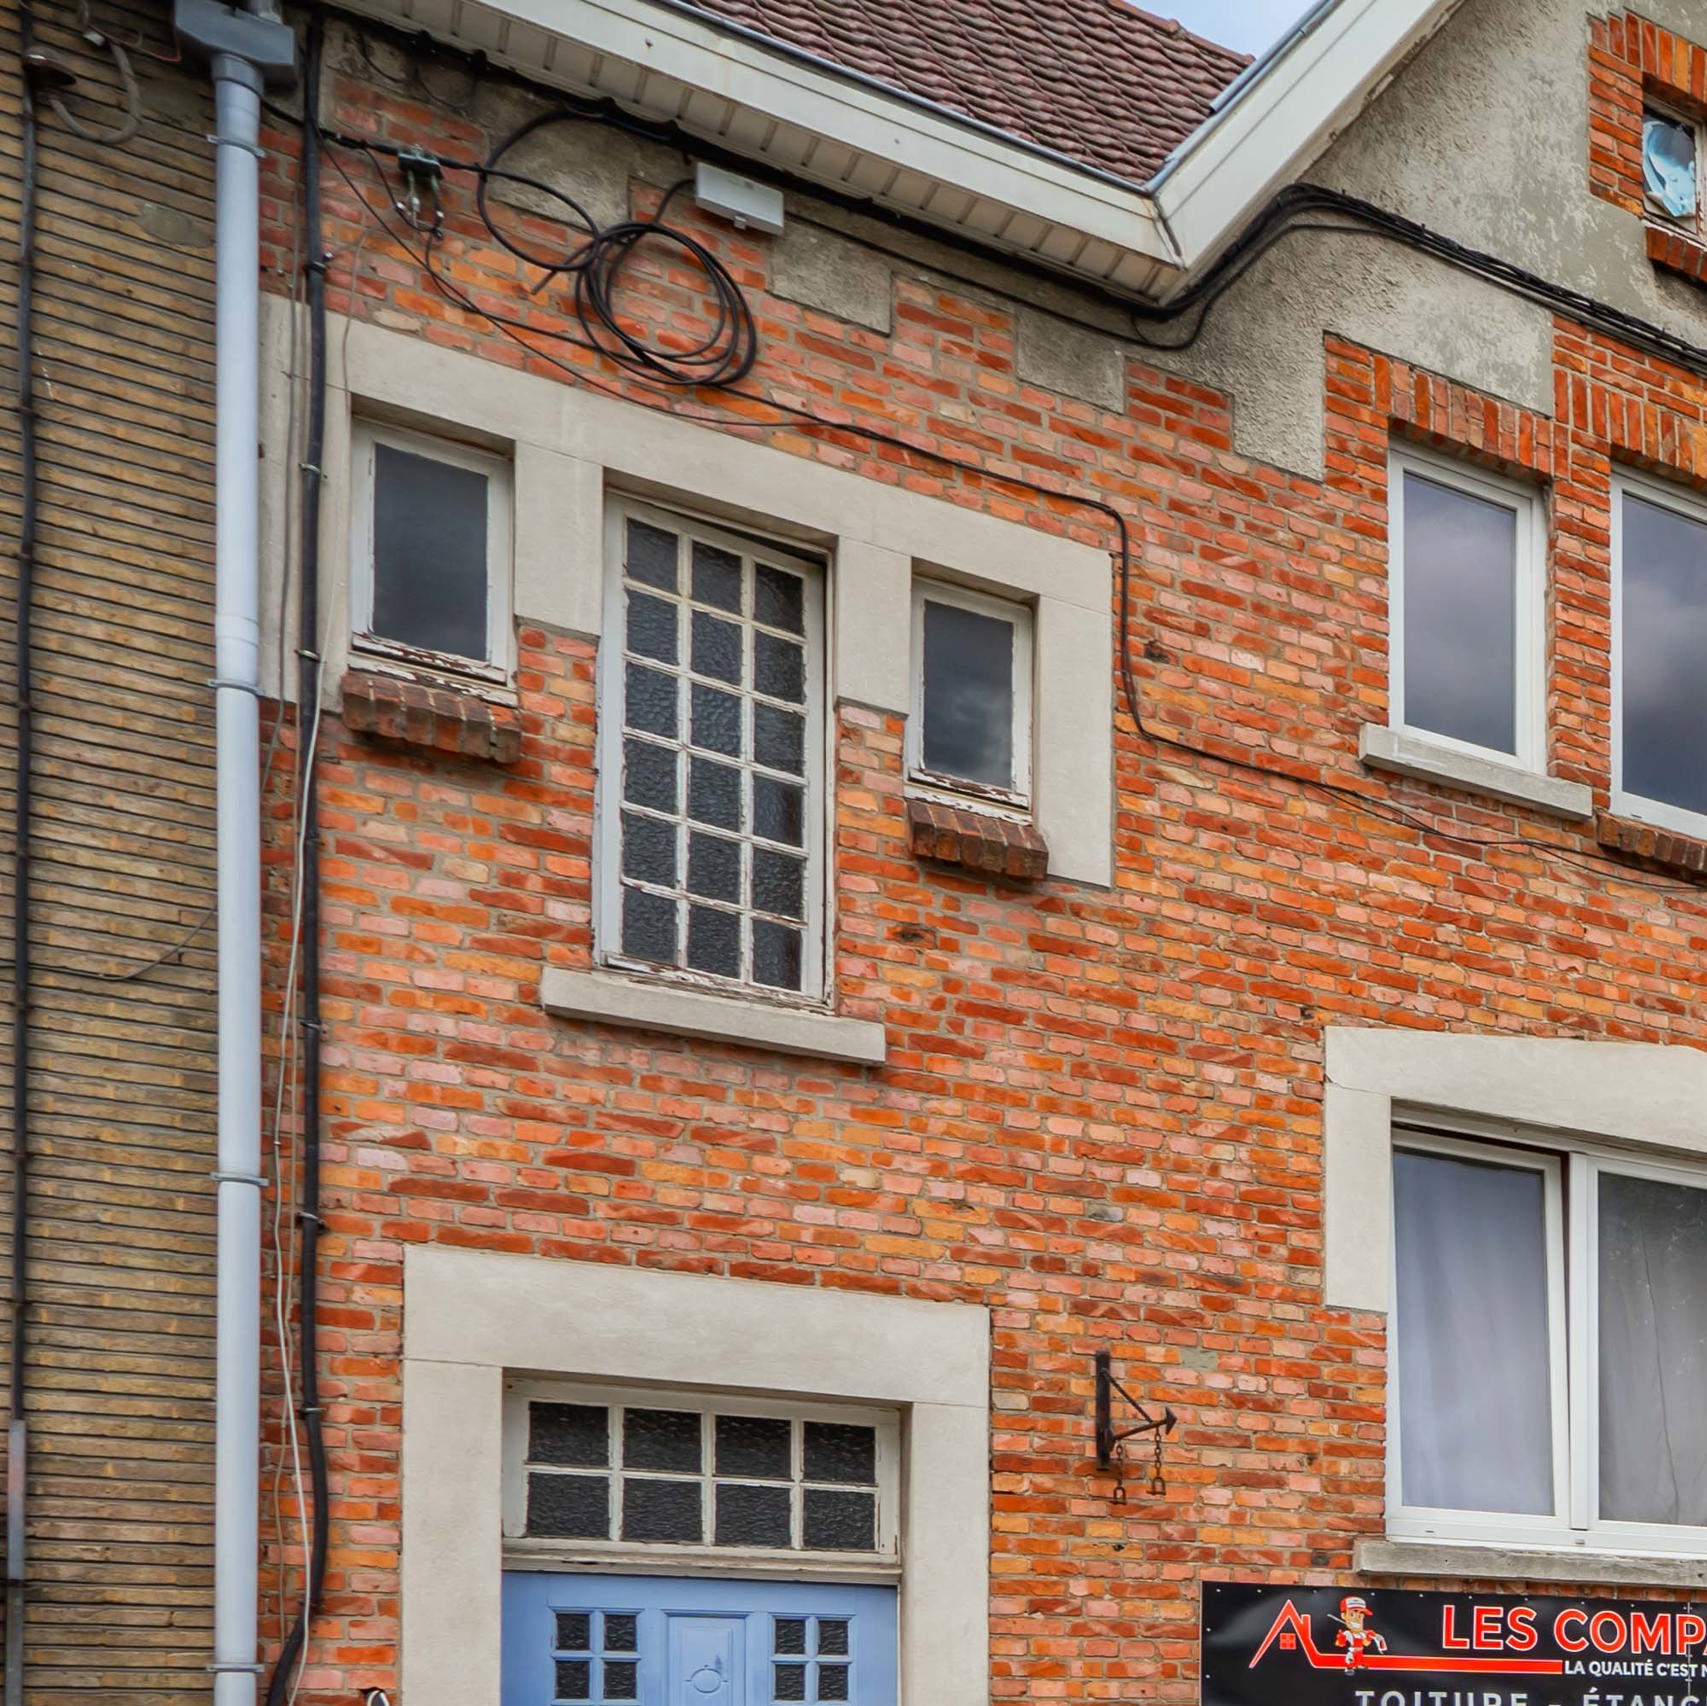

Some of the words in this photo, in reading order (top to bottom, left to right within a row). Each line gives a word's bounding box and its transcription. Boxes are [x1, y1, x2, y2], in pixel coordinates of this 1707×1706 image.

[1442, 1604, 1538, 1651] LES
[1564, 1660, 1585, 1675] LA
[1588, 1659, 1653, 1678] QUALITÉ
[1656, 1664, 1697, 1678] C'EST
